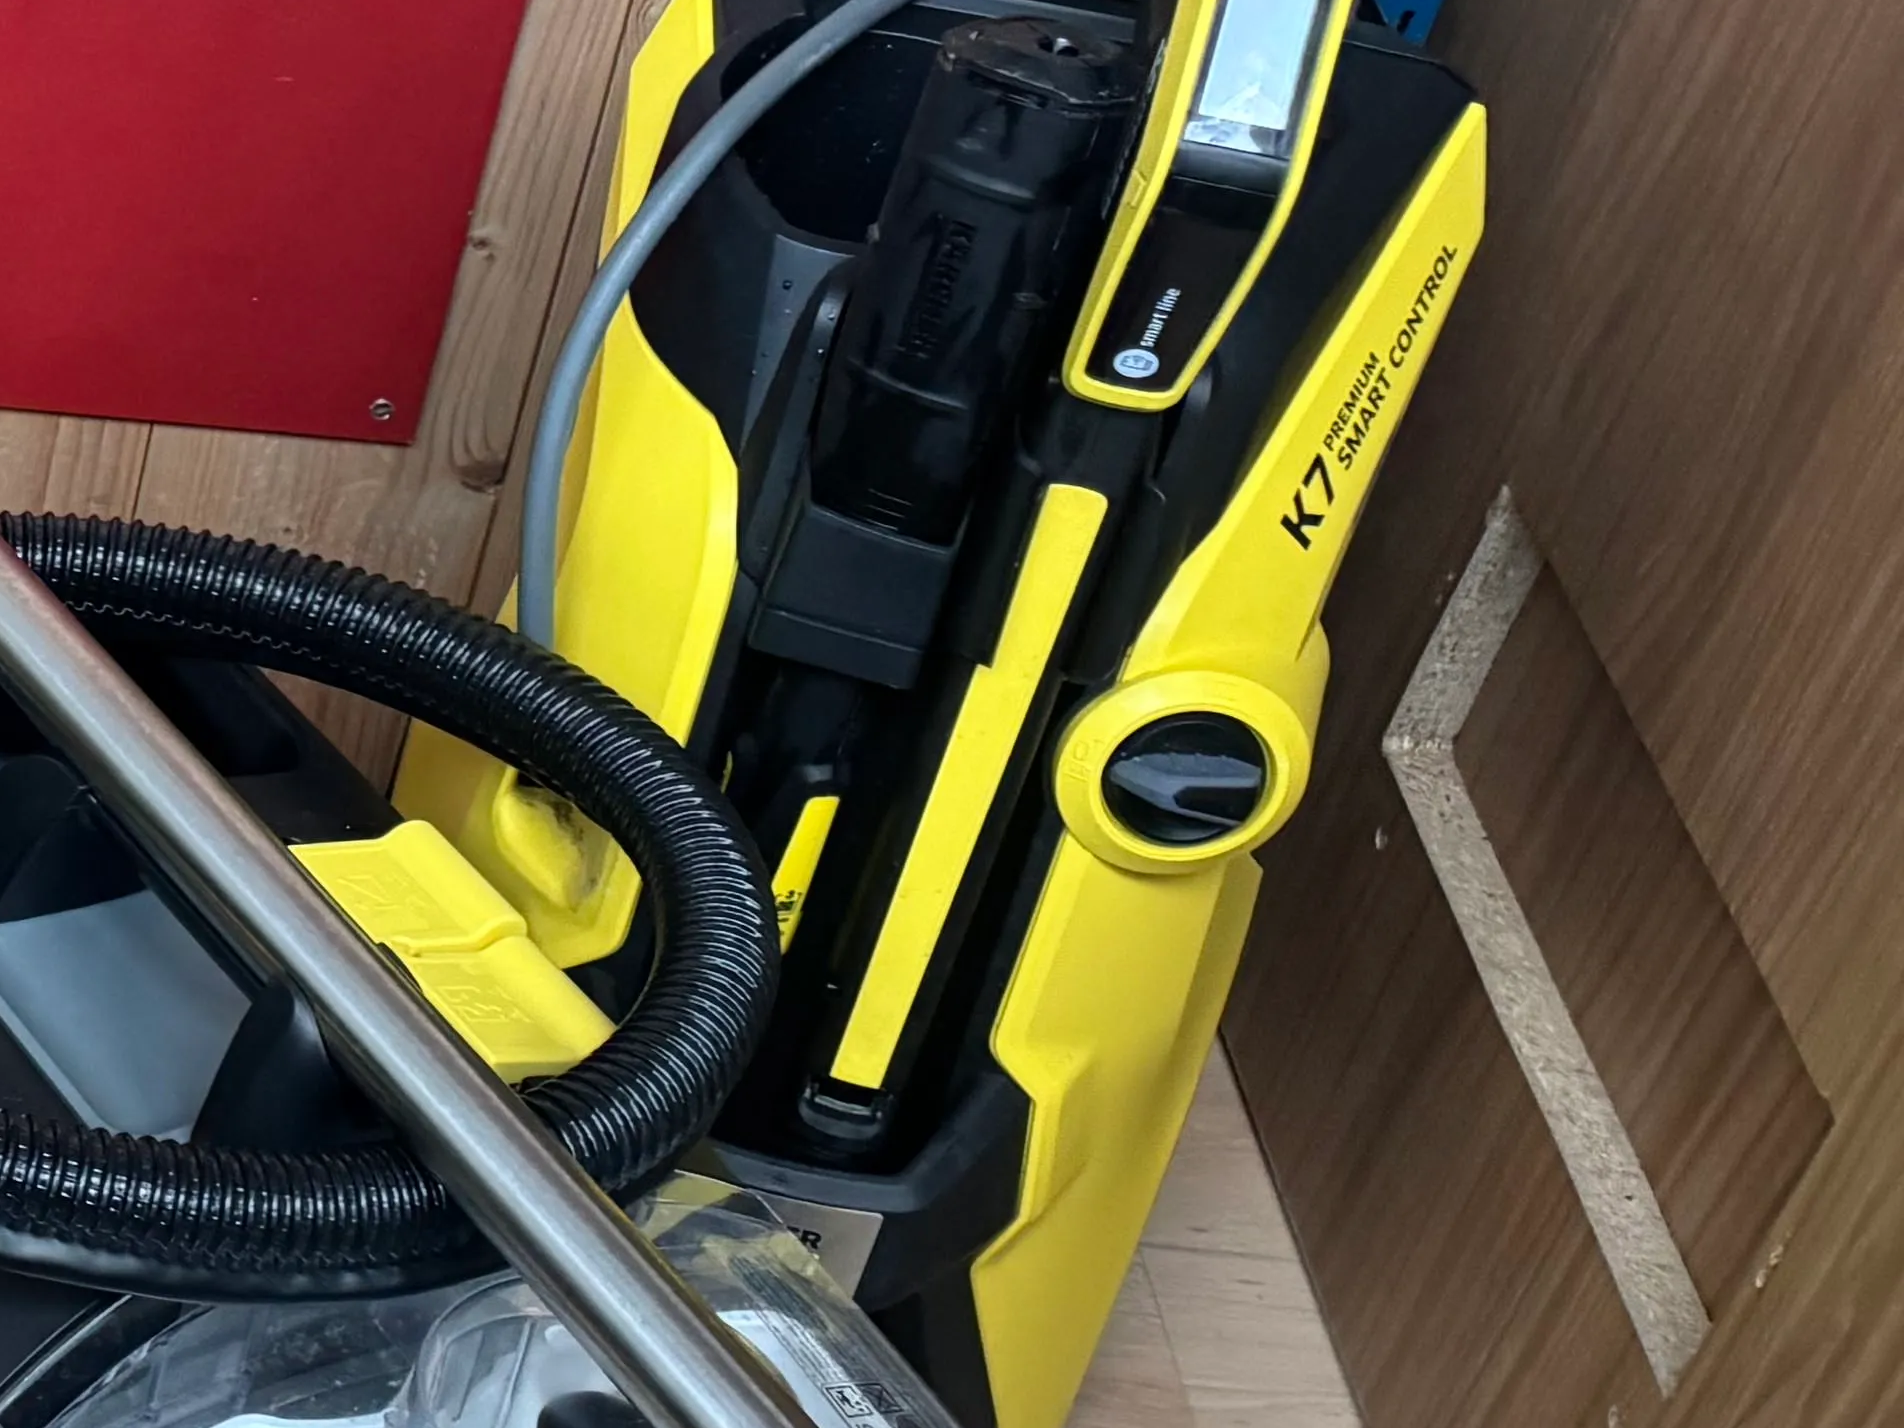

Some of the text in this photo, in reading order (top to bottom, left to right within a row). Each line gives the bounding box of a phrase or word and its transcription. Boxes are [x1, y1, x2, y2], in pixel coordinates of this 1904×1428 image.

[1140, 288, 1181, 347] smart line
[1338, 245, 1457, 470] SMART CONTROL
[1280, 352, 1380, 550] K7 PREMIUM
